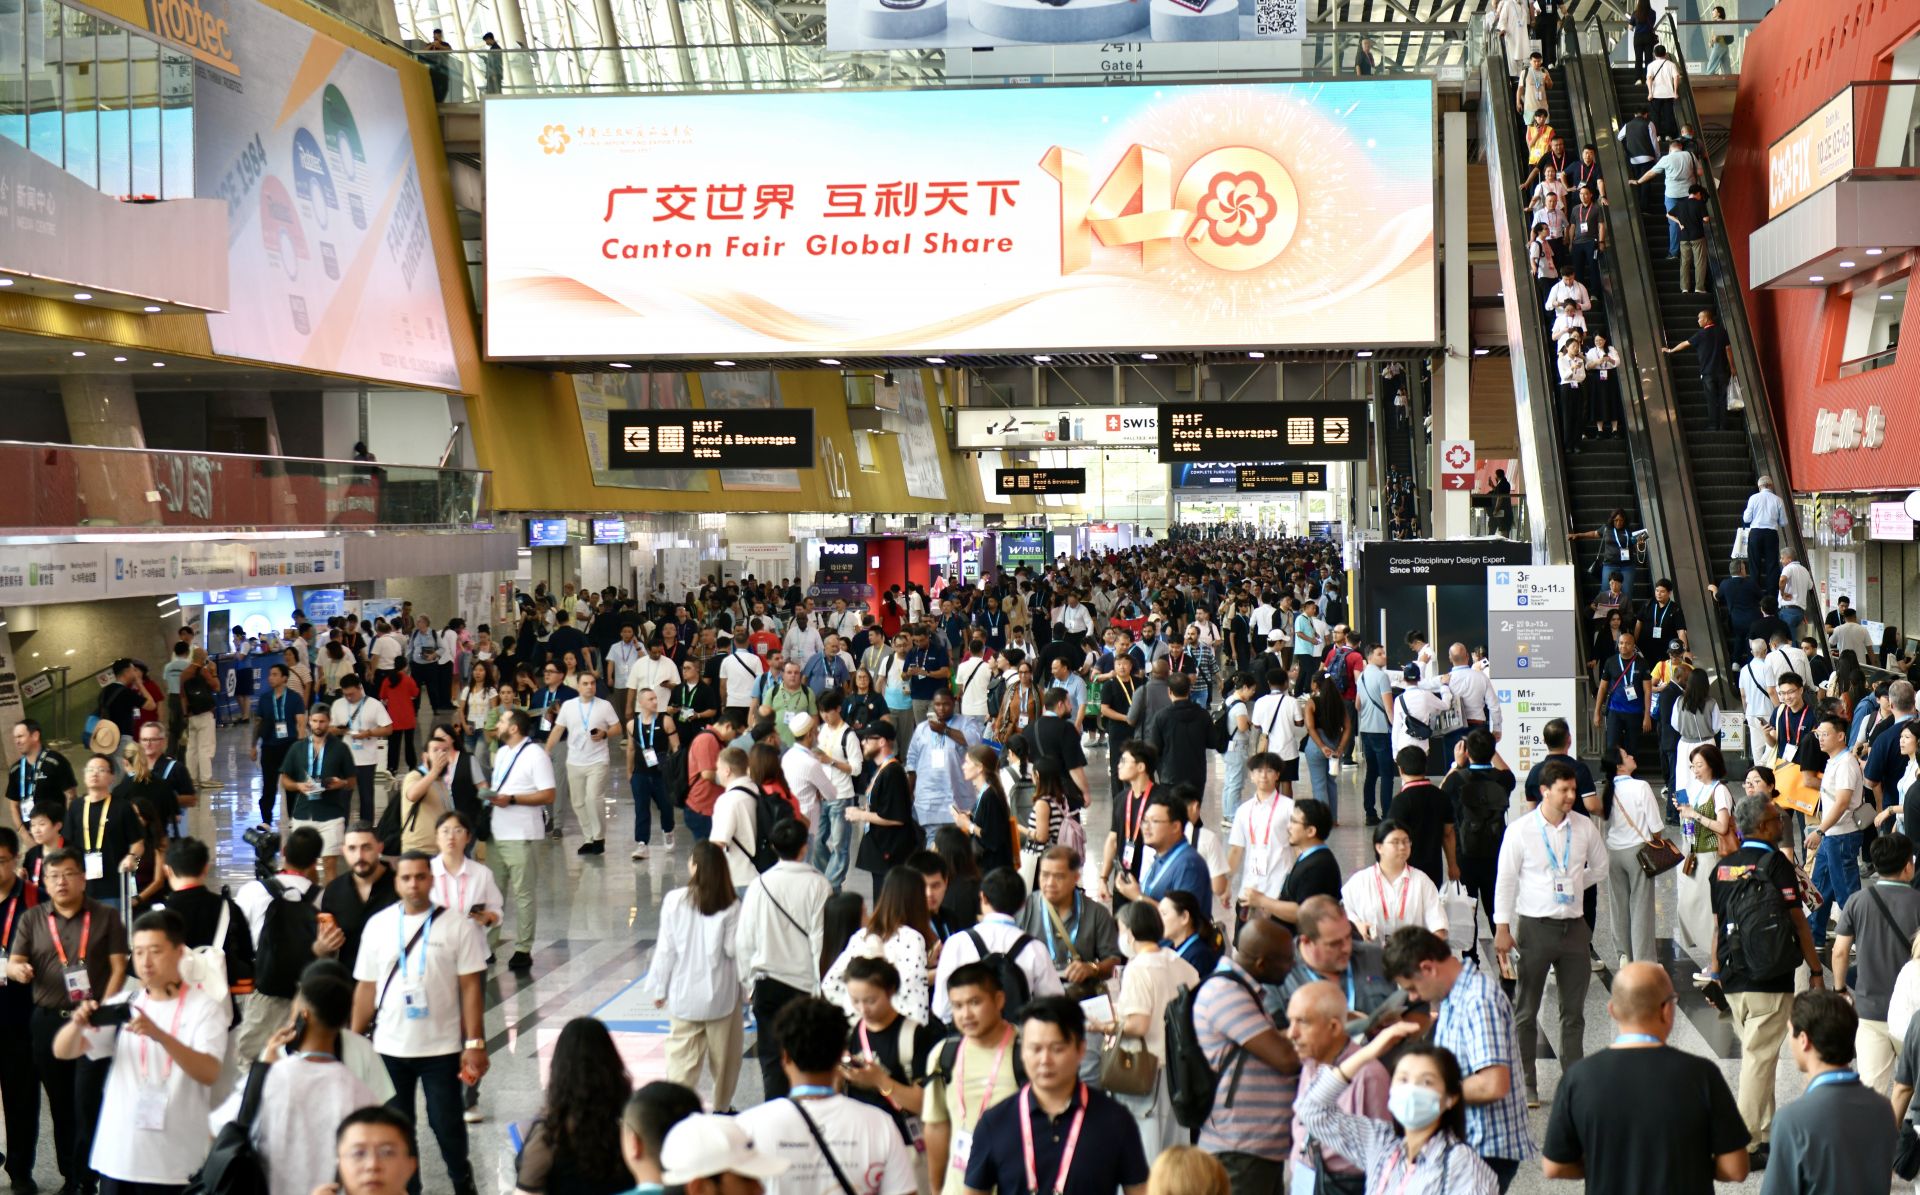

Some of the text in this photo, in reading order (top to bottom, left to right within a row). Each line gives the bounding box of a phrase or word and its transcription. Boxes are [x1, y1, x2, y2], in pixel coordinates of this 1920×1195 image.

[1101, 59, 1143, 71] Gate 4
[236, 131, 268, 196] 1984
[603, 180, 1020, 222] 广交世界 互利天下
[386, 167, 420, 264] FACTORY
[1038, 143, 1298, 276] 140
[402, 212, 428, 291] DIRECT
[602, 232, 1014, 260] Canton Fair Global Share
[692, 420, 723, 432] M1F
[1172, 414, 1203, 426] M1F
[1172, 428, 1278, 439] Food & Beverages
[692, 435, 796, 446] Food & Beverages
[1390, 556, 1505, 565] Cross-Disciplinary Design Expert
[1517, 572, 1530, 582] 3F
[1531, 584, 1565, 593] 9.3-11.3
[1501, 621, 1514, 632] 2F
[1519, 723, 1531, 733] 1F
[1533, 736, 1545, 744] 9.
